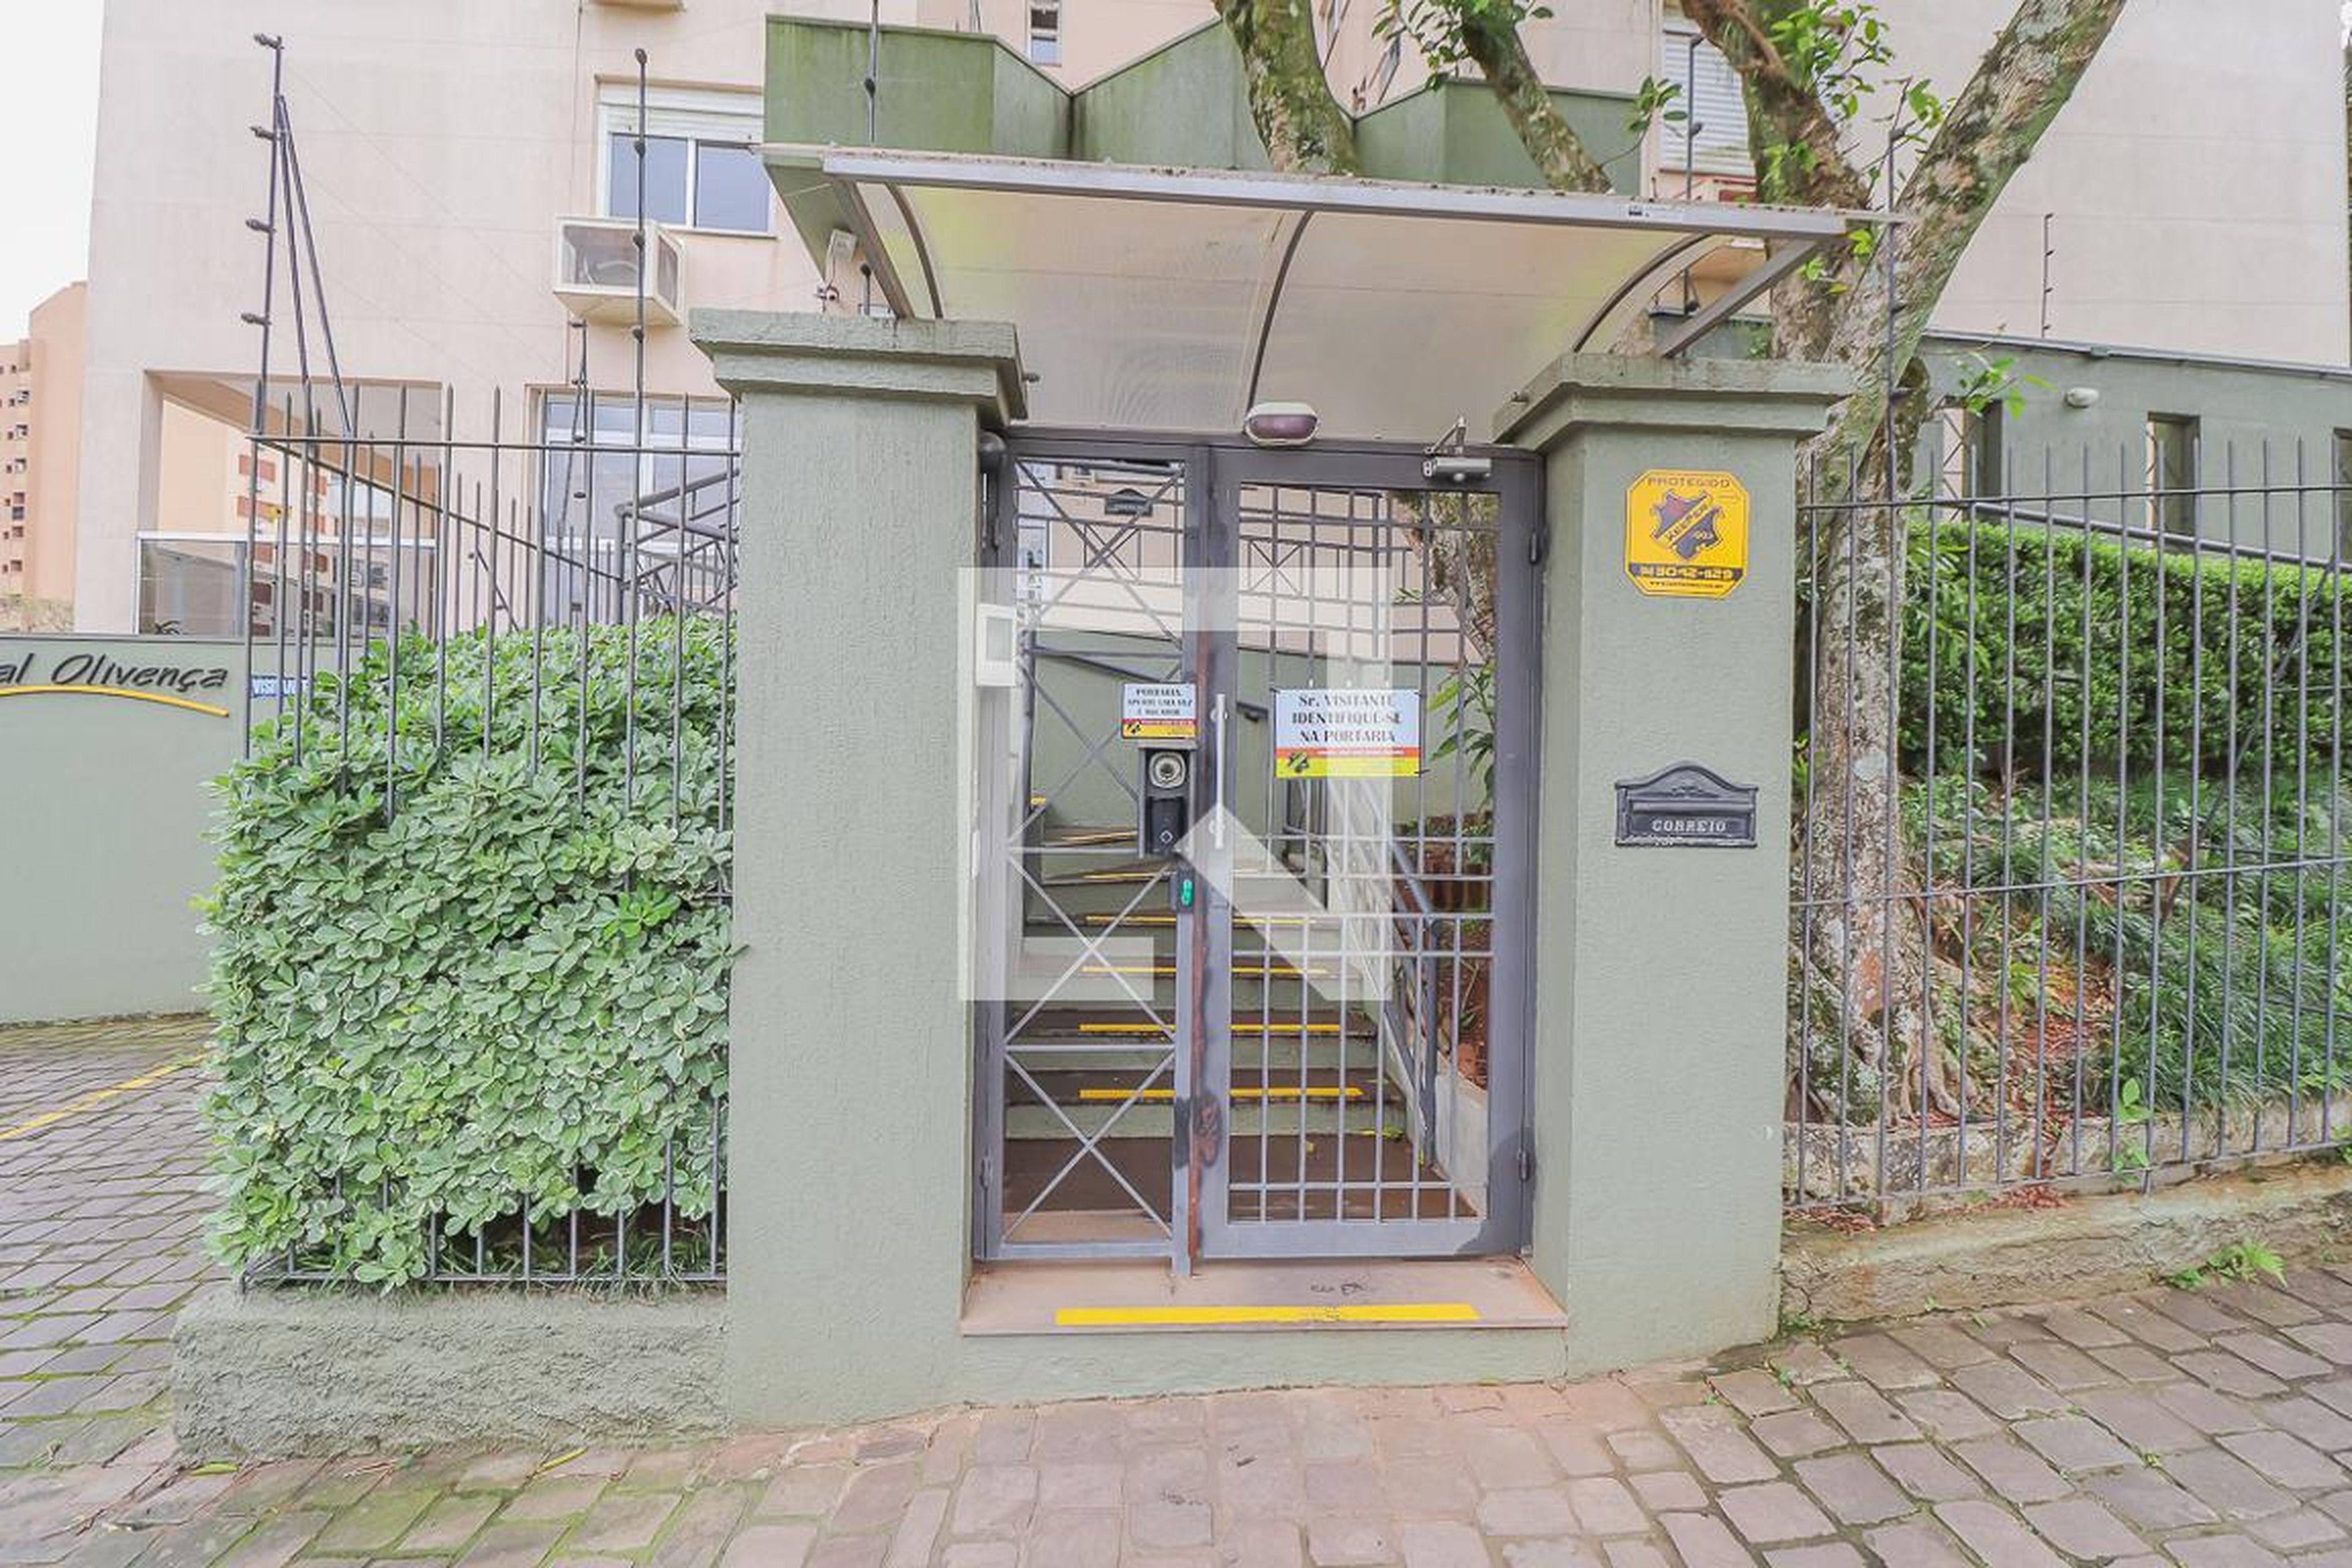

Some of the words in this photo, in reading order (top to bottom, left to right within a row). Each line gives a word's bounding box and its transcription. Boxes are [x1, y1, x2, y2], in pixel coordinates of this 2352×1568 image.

[50, 653, 228, 693] Olivença
[1298, 696, 1320, 707] Sr.
[1324, 695, 1396, 706] VISITANTE
[1300, 731, 1319, 742] NA
[1324, 730, 1396, 742] PORTARIA
[1652, 820, 1726, 832] CORREIO
